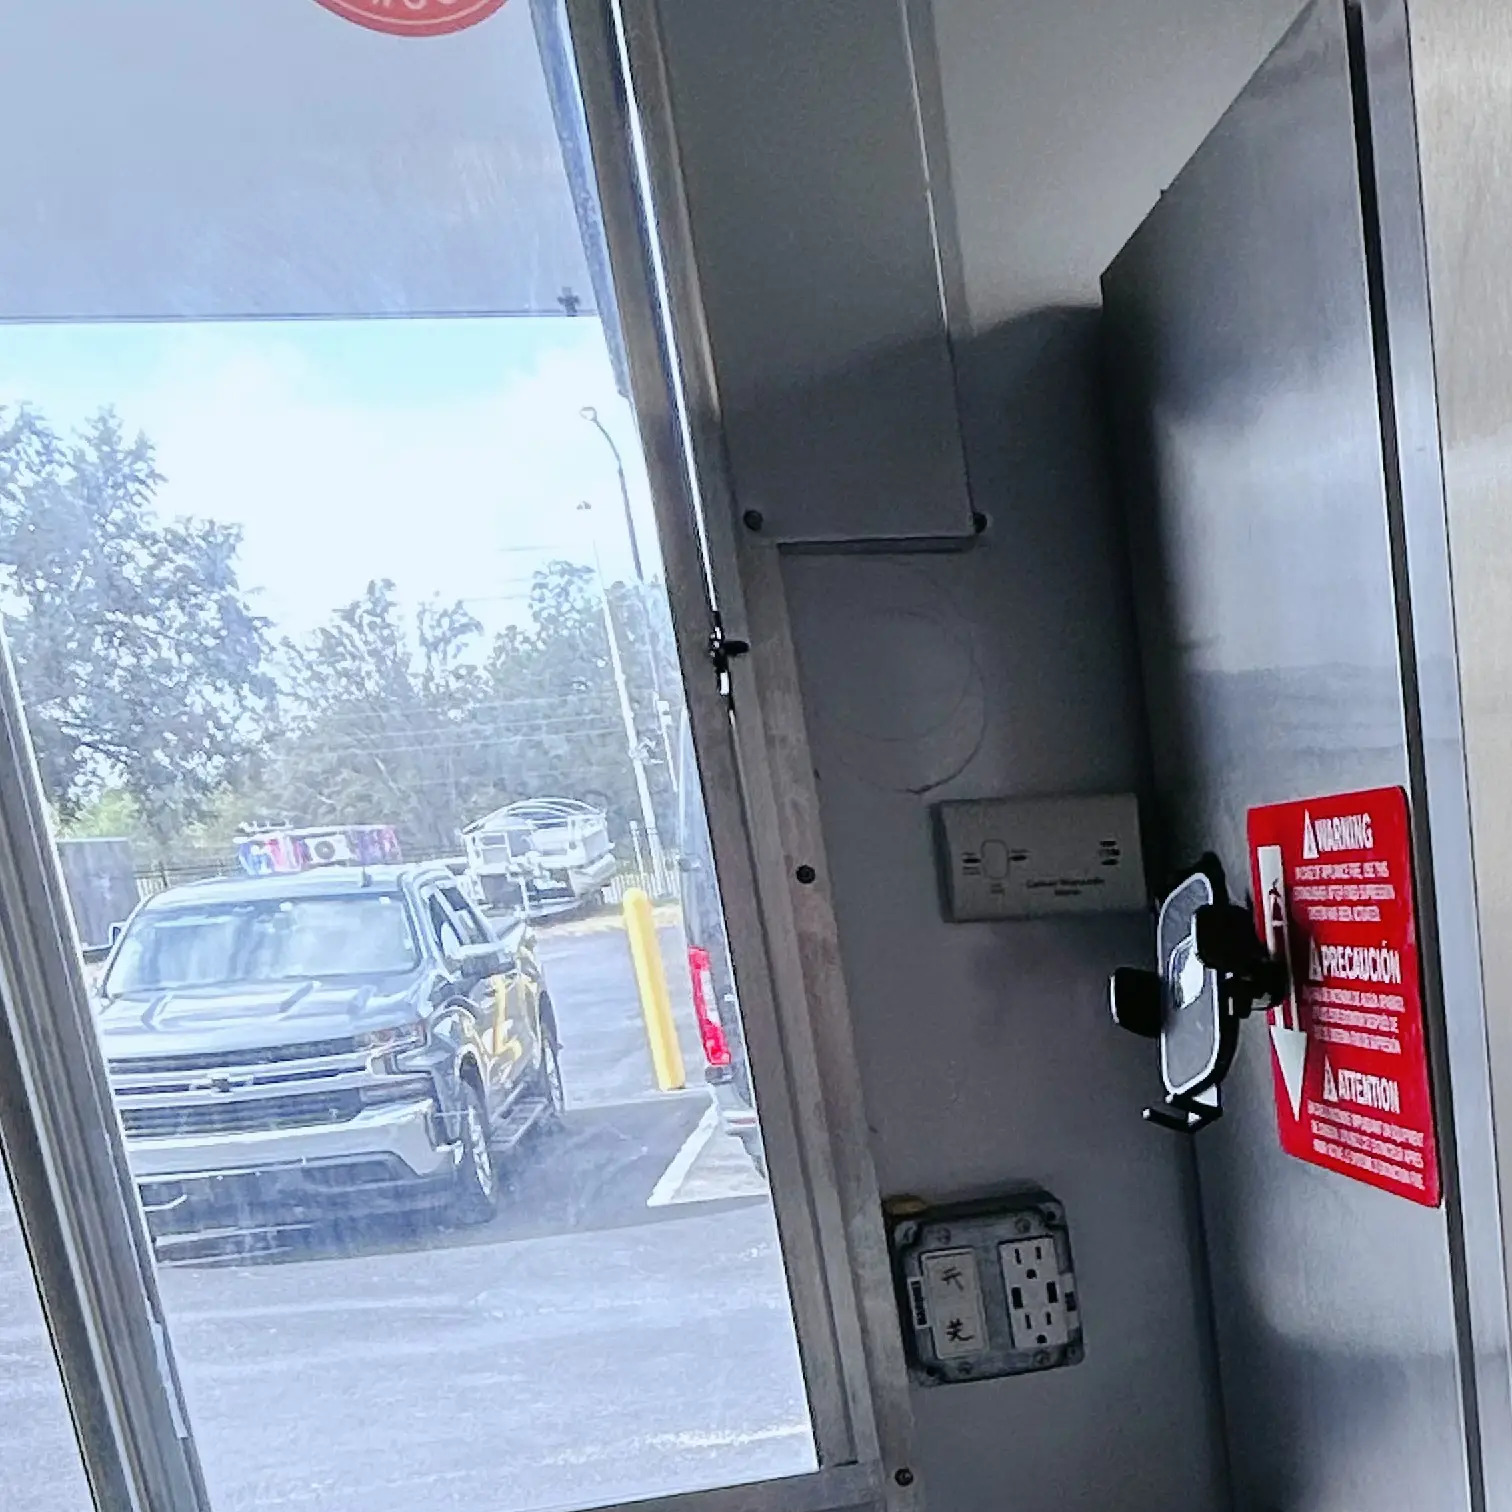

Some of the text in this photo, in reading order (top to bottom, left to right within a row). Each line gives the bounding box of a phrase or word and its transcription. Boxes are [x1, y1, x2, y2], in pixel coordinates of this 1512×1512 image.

[1314, 812, 1374, 852] WARNING
[1320, 939, 1402, 985] PRECAUCIÓN
[1338, 1068, 1401, 1115] ATTENTION
